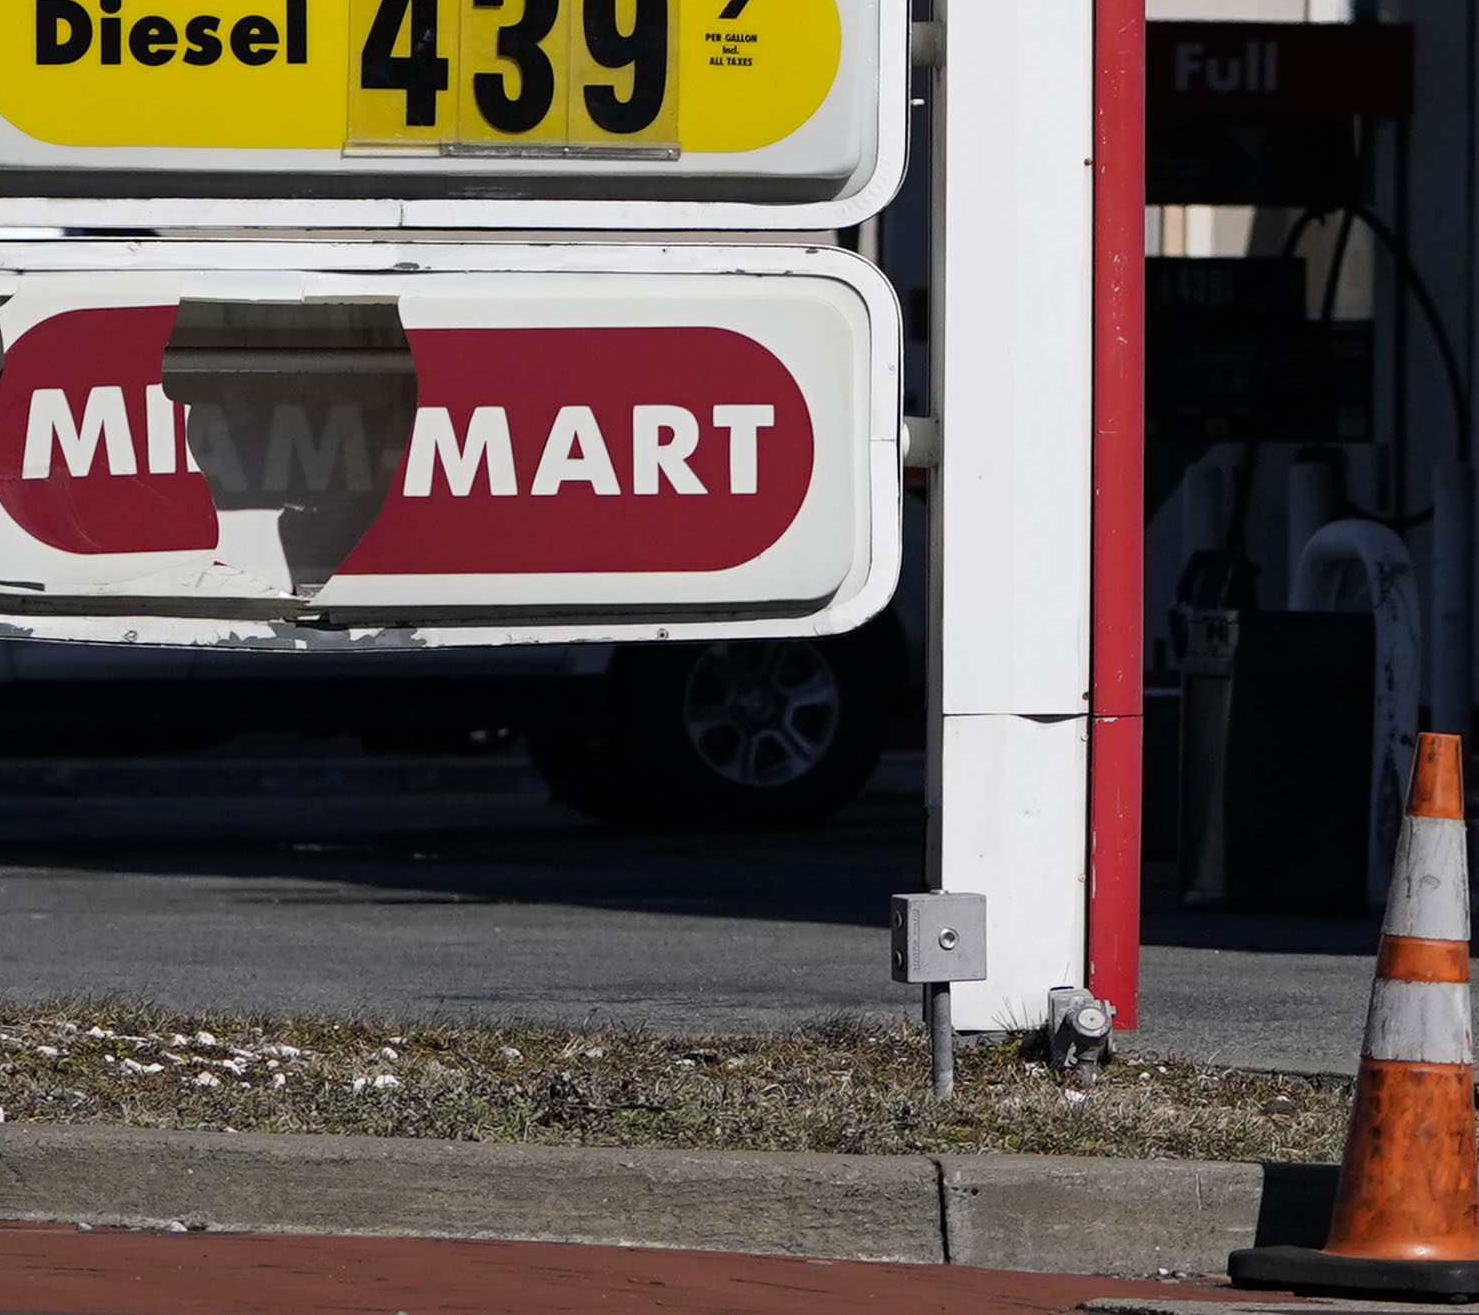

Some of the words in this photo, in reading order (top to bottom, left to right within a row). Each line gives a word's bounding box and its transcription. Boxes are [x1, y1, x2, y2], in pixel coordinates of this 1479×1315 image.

[705, 32, 722, 42] PER
[725, 33, 758, 43] GALLON
[709, 56, 725, 67] ALL
[726, 57, 753, 67] TAXES
[1173, 41, 1280, 93] Full
